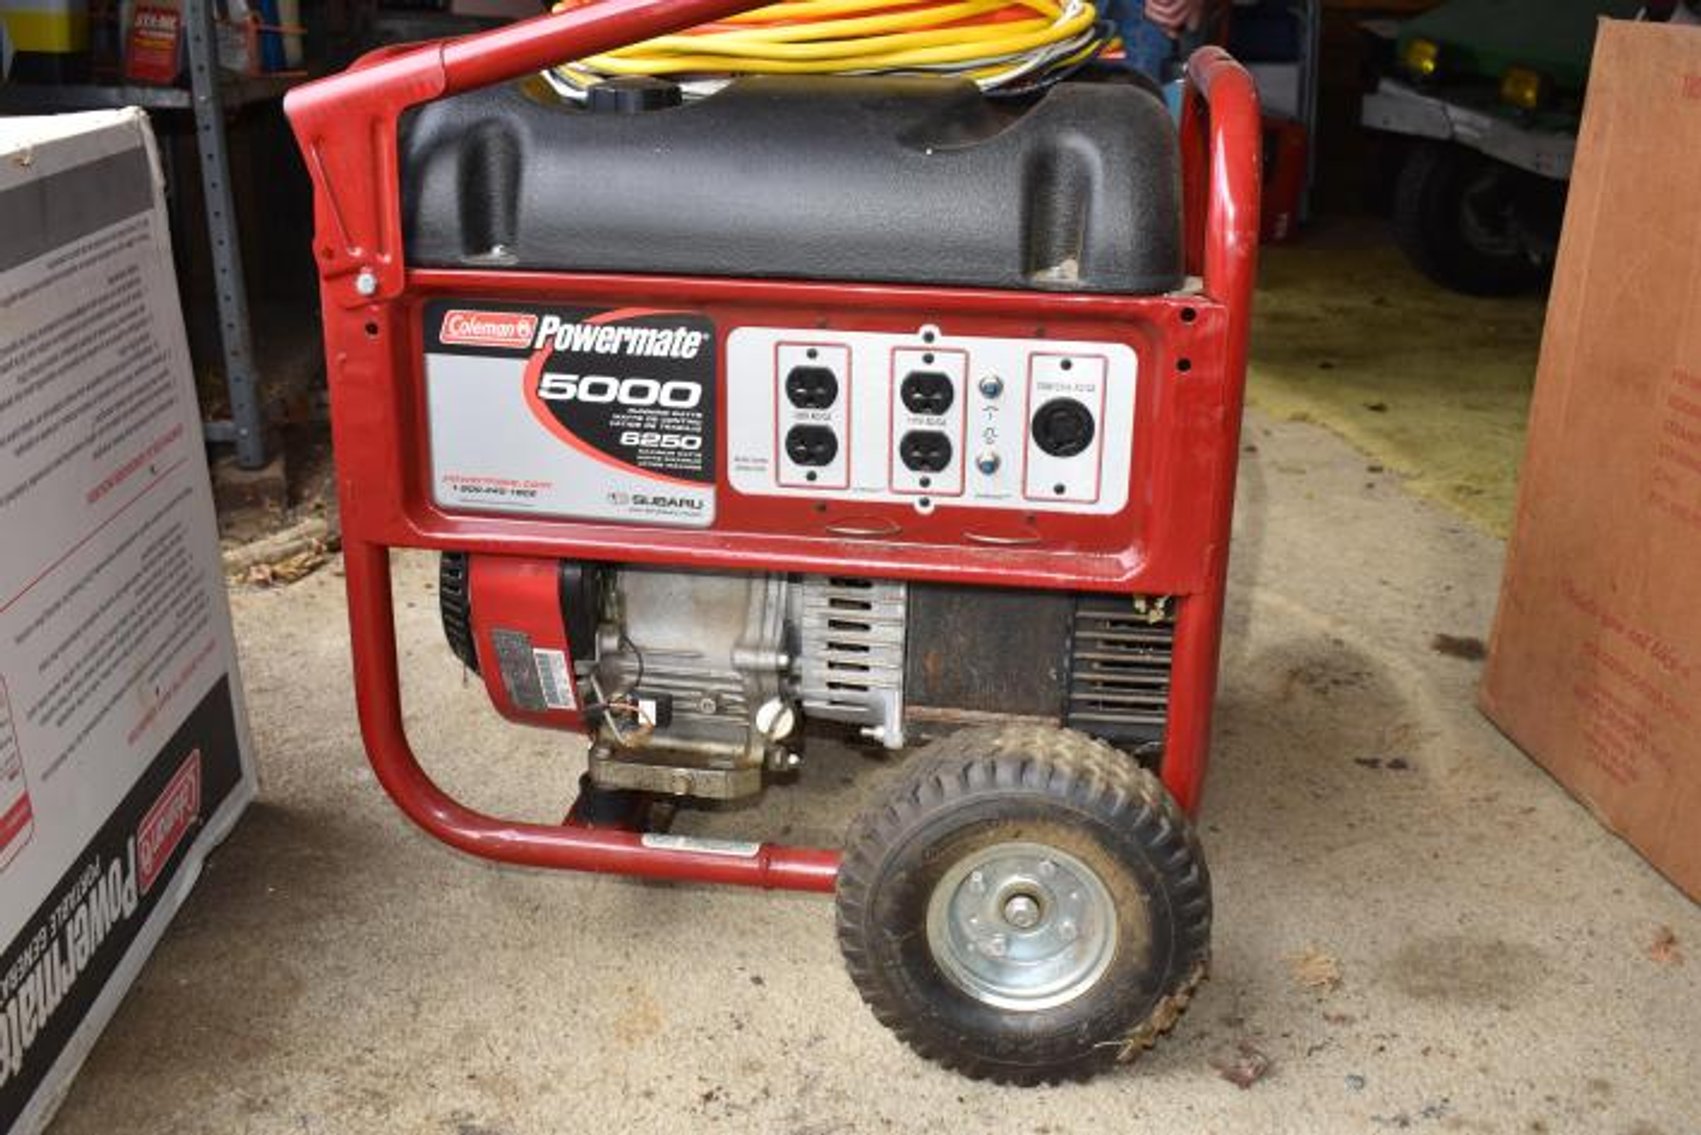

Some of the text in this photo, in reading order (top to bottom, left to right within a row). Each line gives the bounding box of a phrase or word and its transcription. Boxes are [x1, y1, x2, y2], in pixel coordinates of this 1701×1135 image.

[449, 314, 703, 359] Coleman Powermate
[538, 373, 703, 409] 5000
[620, 431, 703, 450] 6250
[632, 493, 704, 510] SUBARU
[0, 853, 102, 1003] PORTABLE GENERA
